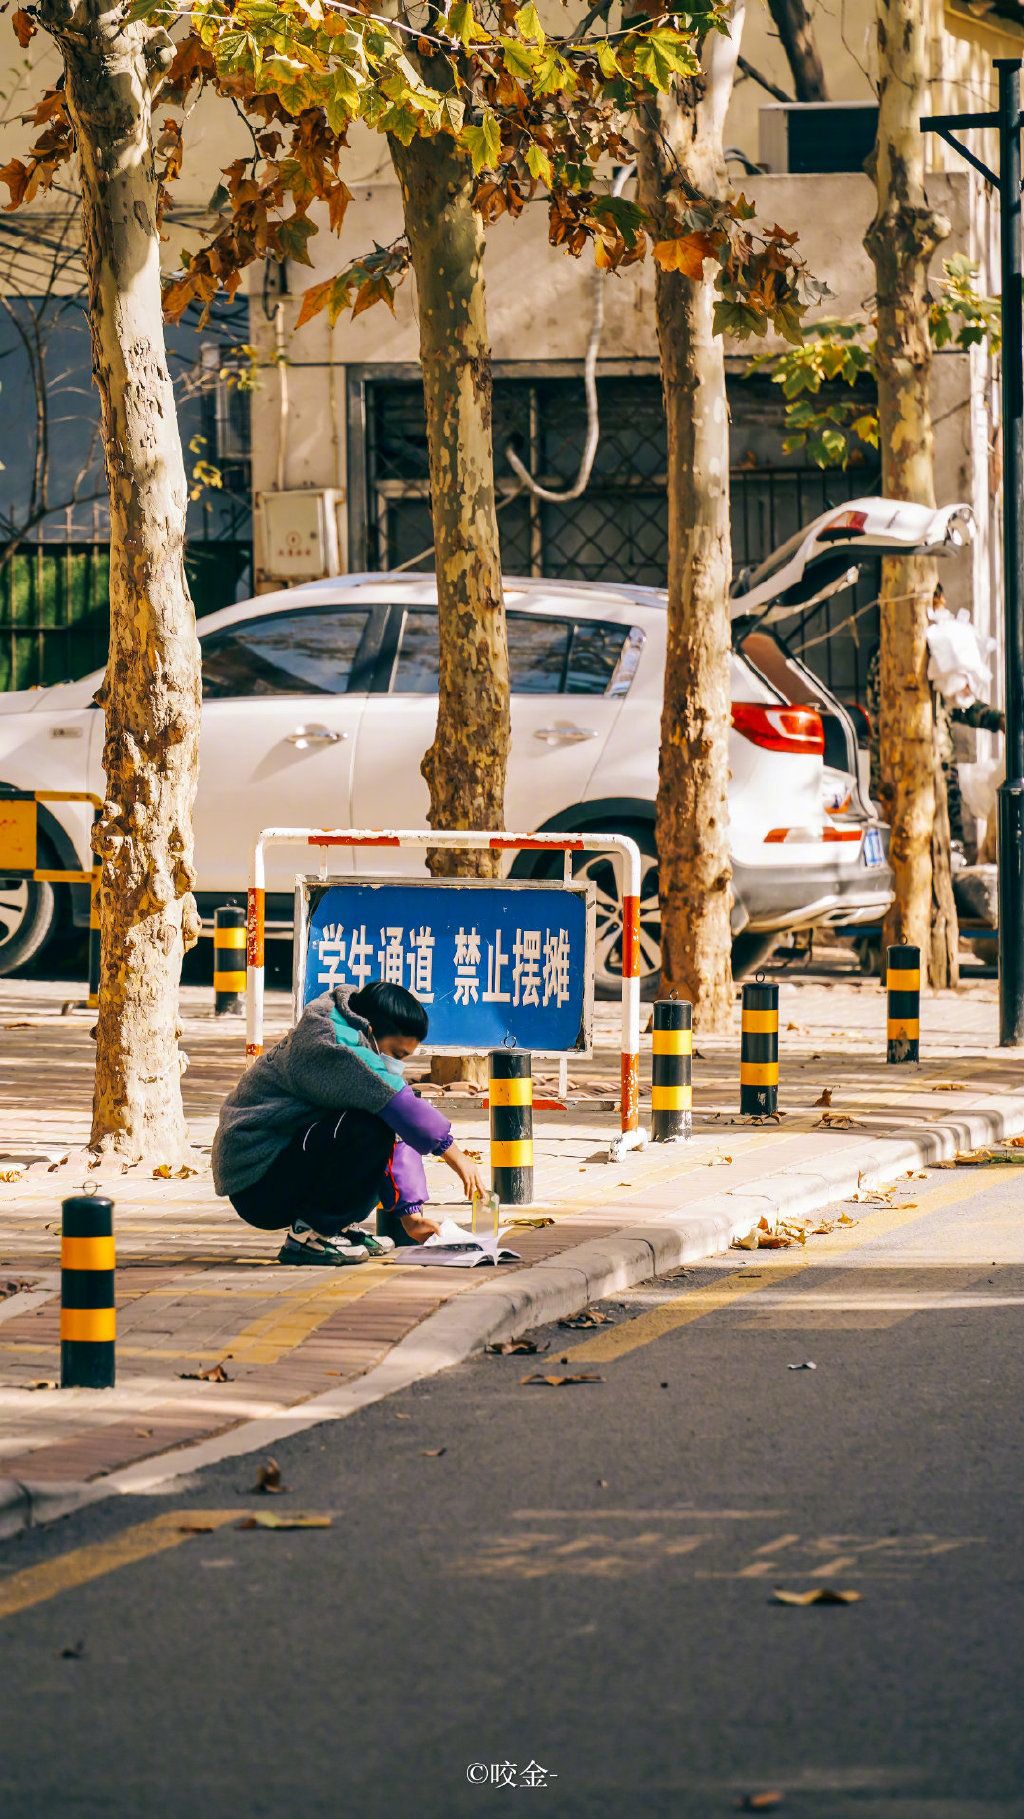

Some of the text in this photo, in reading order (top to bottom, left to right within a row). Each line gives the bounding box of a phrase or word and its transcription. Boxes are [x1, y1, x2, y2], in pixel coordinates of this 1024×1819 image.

[317, 923, 570, 1007] 学生通道 禁止摆摊
